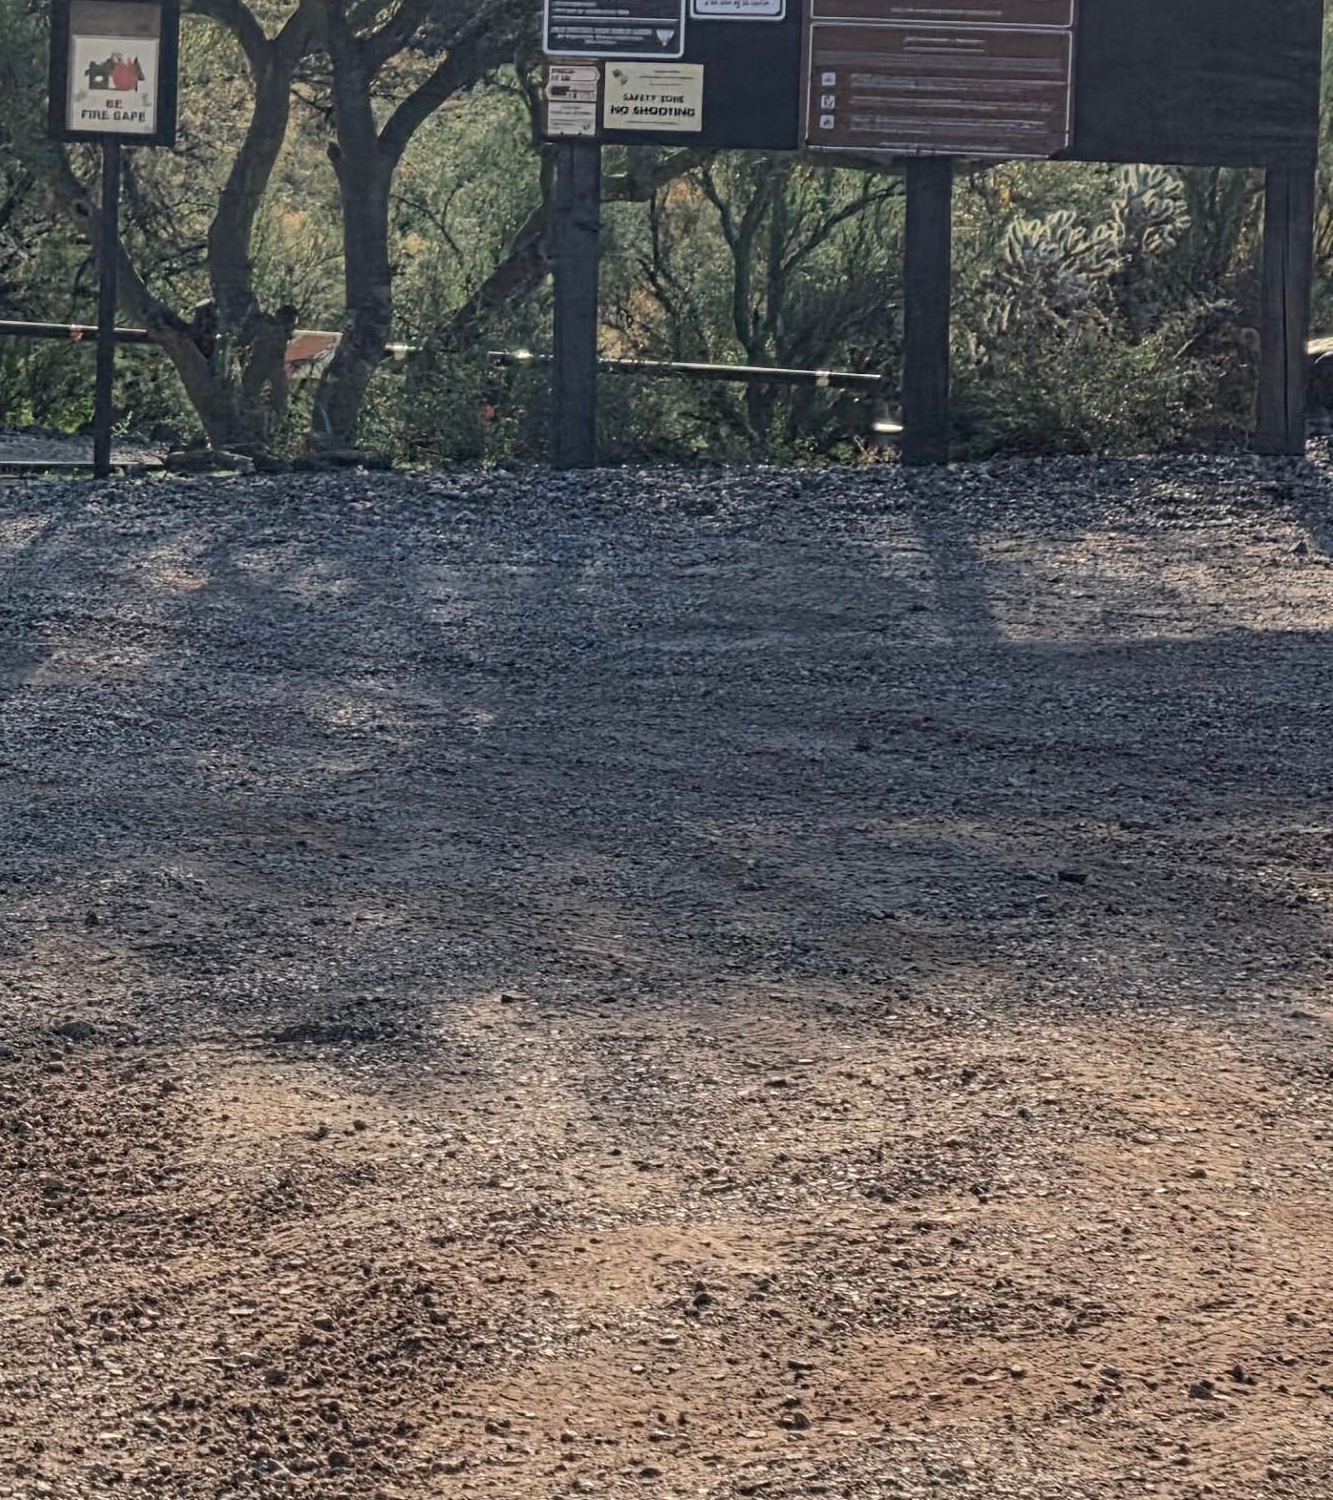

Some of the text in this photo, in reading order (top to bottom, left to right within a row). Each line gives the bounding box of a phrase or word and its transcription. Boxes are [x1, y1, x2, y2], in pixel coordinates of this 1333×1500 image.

[622, 92, 656, 103] SAFETY
[105, 99, 122, 109] BE
[81, 109, 146, 122] FIRE SAFE
[610, 104, 696, 117] NO SHOOTING
